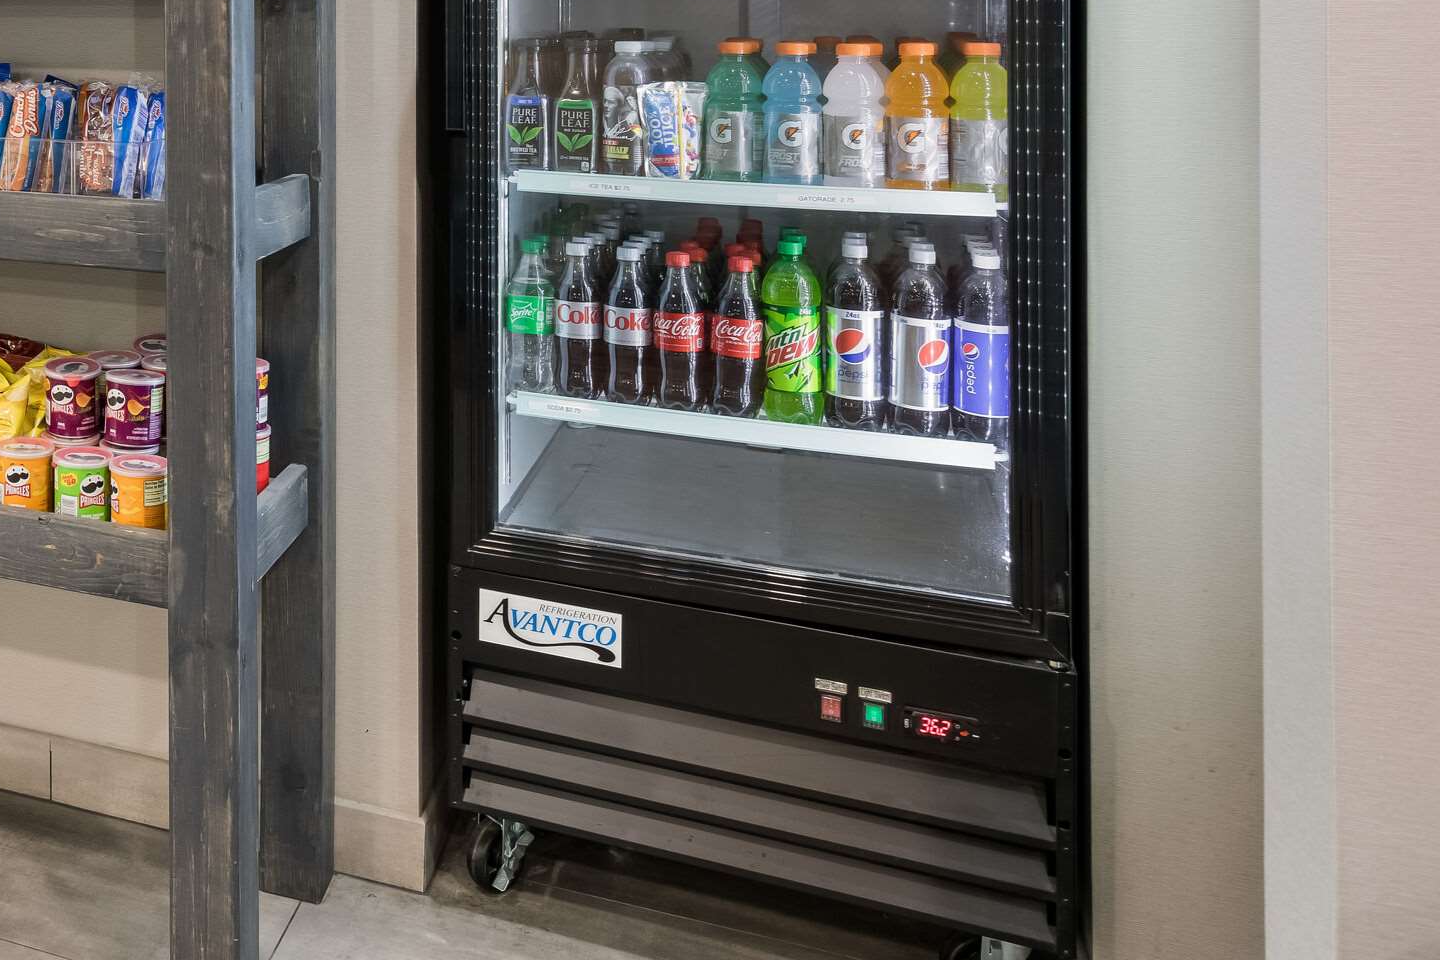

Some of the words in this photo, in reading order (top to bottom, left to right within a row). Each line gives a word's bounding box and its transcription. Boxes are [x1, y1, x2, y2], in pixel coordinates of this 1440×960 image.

[10, 90, 25, 138] Crunch
[23, 88, 38, 137] Donuts
[512, 107, 537, 117] PURE
[560, 110, 590, 120] PURE
[659, 104, 672, 149] JUICE
[511, 308, 533, 318] Sprite
[557, 303, 601, 325] Coke
[604, 308, 651, 331] Coke
[653, 312, 702, 337] Coca-Cola
[767, 330, 818, 368] DEW
[966, 360, 977, 395] pepsi
[4, 484, 30, 497] PRINGLES
[79, 493, 105, 507] PRINGLES
[483, 597, 617, 647] AVANTCO
[539, 603, 618, 625] REFRIGERATION
